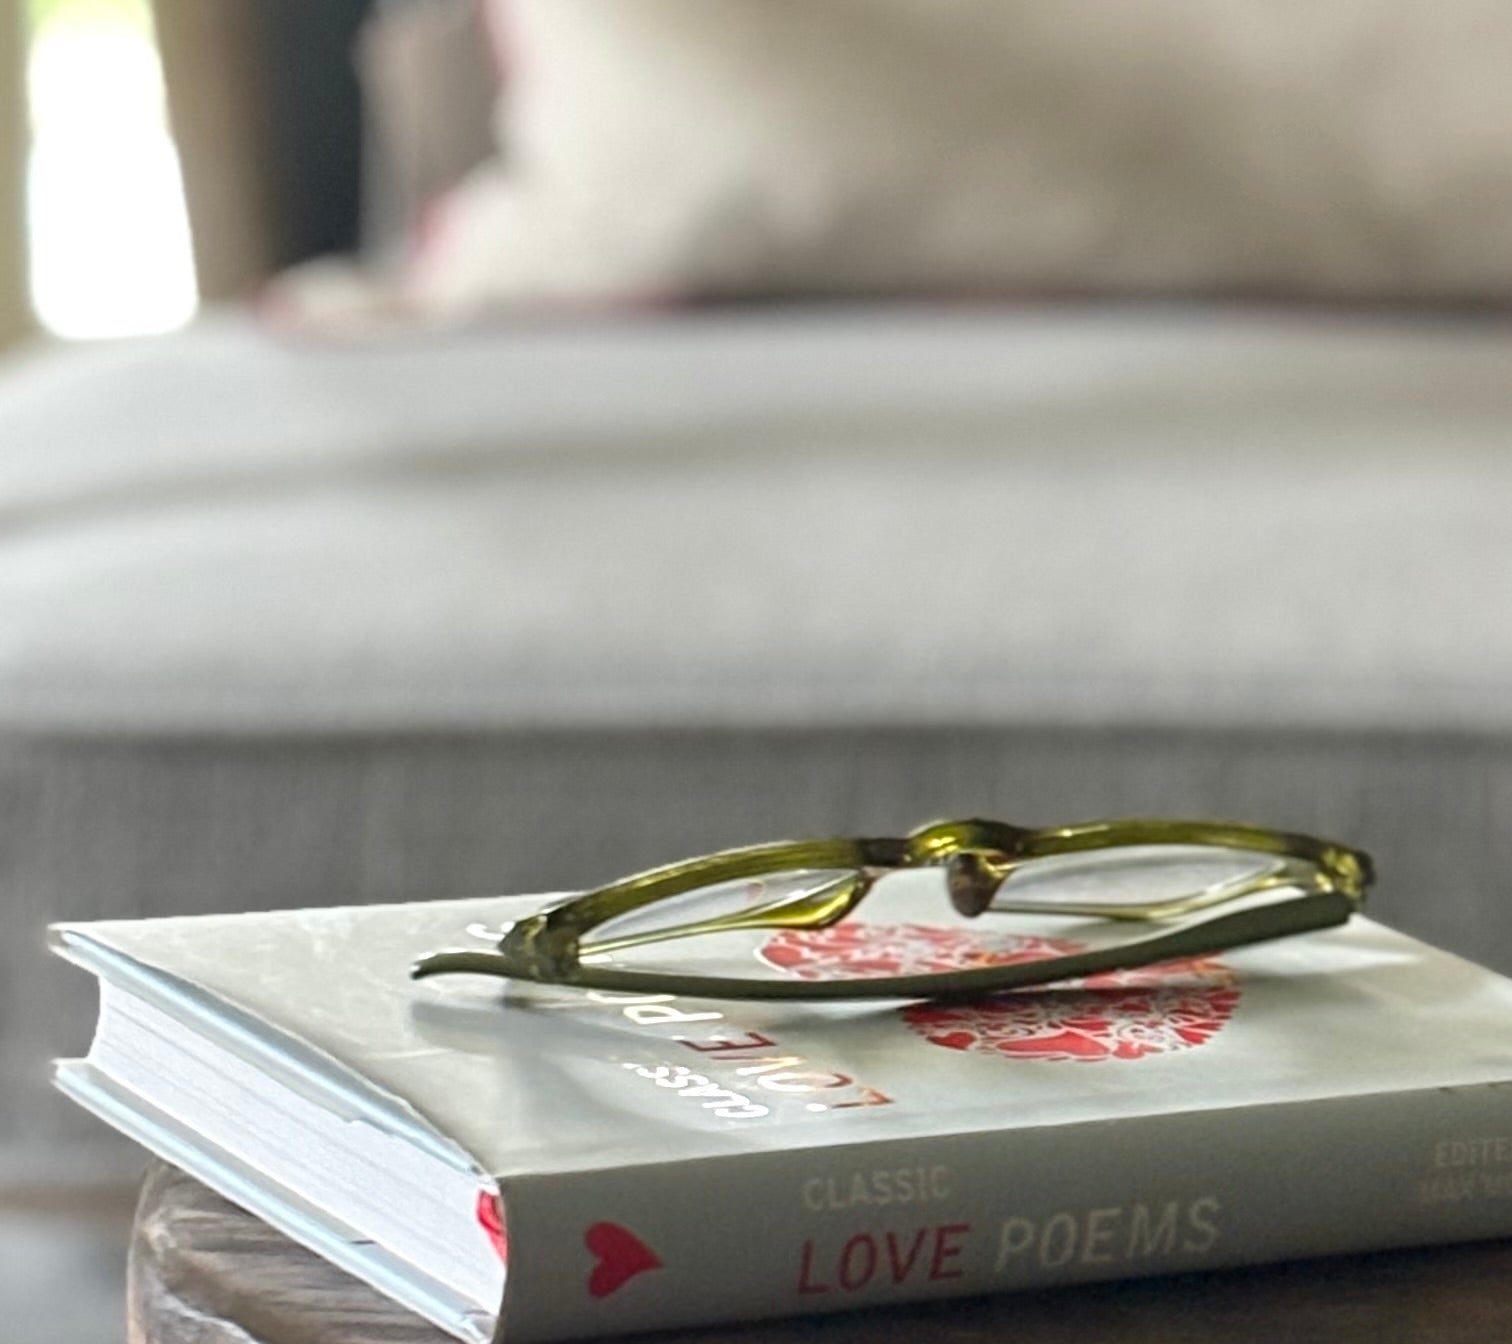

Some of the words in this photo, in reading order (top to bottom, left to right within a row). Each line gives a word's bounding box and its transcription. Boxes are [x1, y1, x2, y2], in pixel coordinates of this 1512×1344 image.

[803, 1164, 952, 1213] CLASSIC
[798, 1223, 971, 1296] LOVE
[994, 1196, 1221, 1273] POEMS
